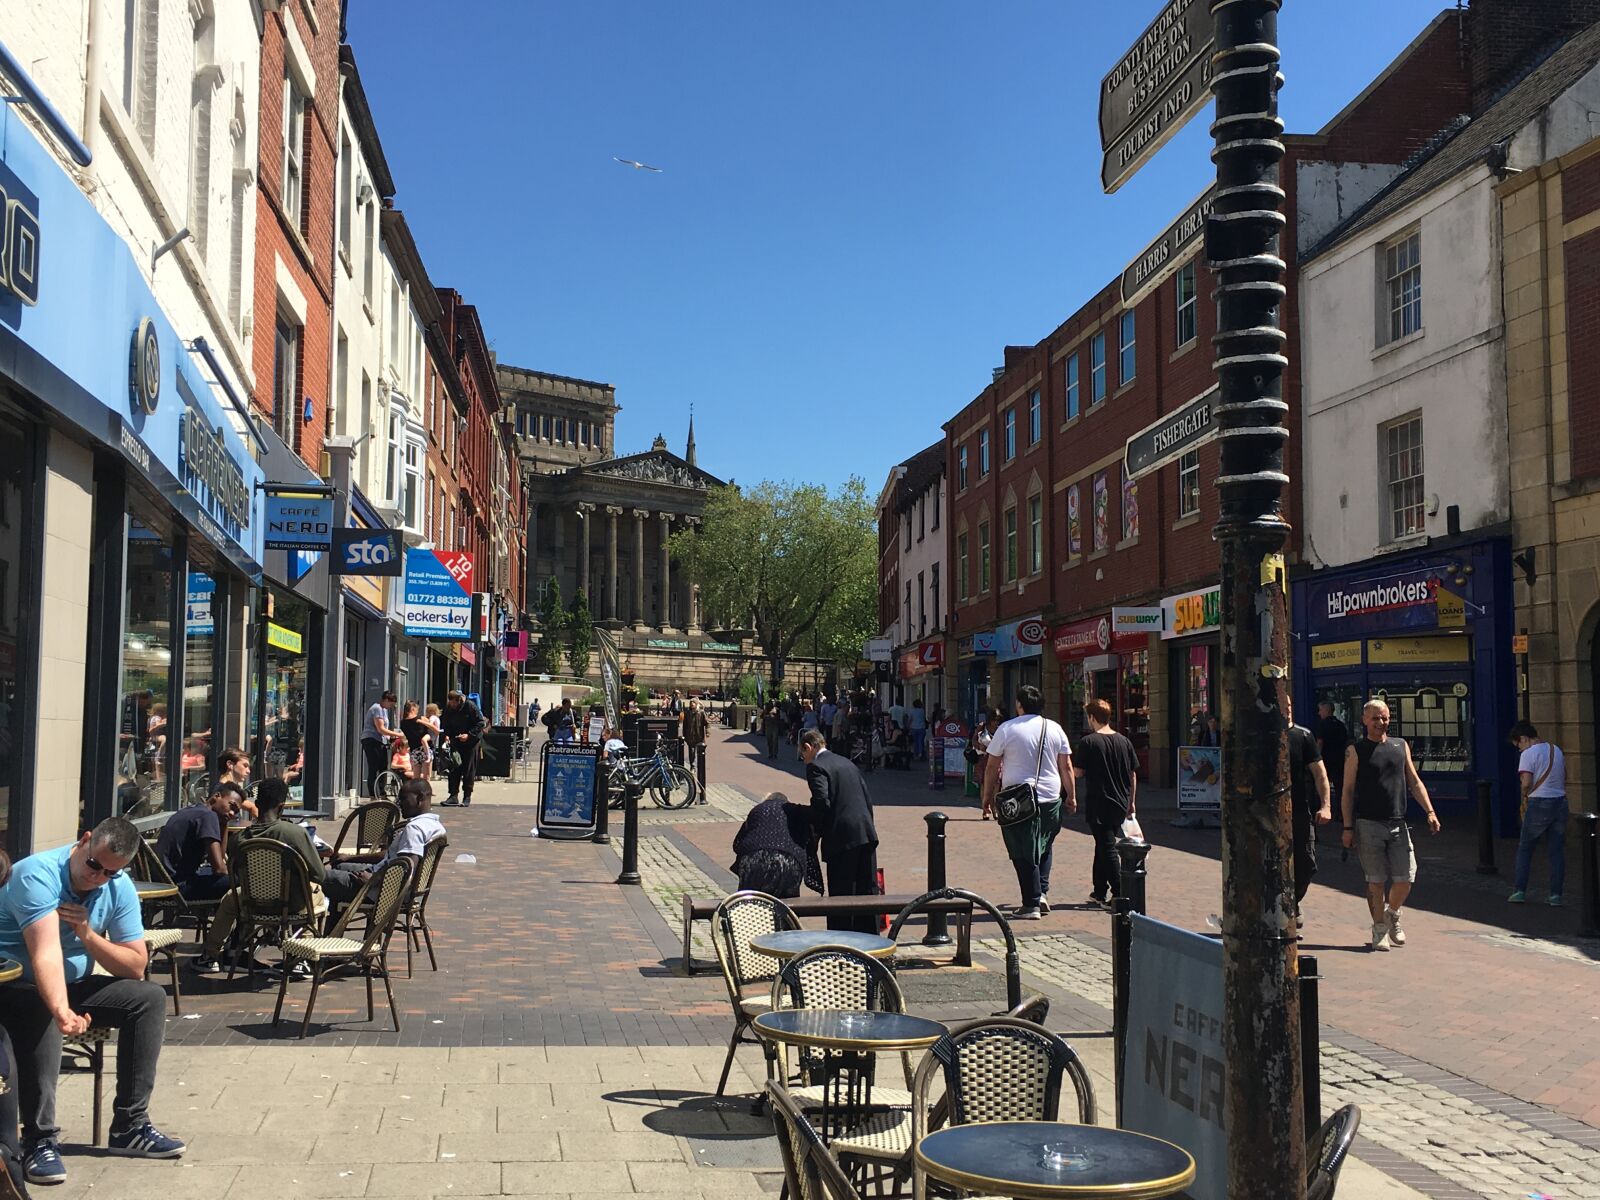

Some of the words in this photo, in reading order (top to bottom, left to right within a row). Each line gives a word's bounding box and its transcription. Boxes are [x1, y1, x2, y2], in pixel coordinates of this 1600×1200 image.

[1107, 43, 1142, 93] COUNTY
[1143, 0, 1193, 53] INFORMA
[1131, 36, 1168, 88] CENTRE
[1170, 17, 1187, 46] ON
[1127, 84, 1148, 116] BUS
[1148, 35, 1191, 93] STATION
[1118, 110, 1160, 167] TOURIST
[1164, 80, 1191, 122] INFO
[1135, 240, 1168, 285] HARRIS
[1153, 404, 1209, 454] FISHERGATE
[269, 522, 328, 534] NERO
[345, 540, 389, 564] sta
[456, 554, 472, 572] TO
[425, 572, 451, 580] Premises
[445, 559, 467, 582] LET
[407, 593, 436, 604] 01772
[436, 596, 470, 606] 883388
[1342, 580, 1428, 613] pawnbrokers
[407, 608, 469, 628] eckersley
[1117, 615, 1160, 624] SUBWAY
[1439, 607, 1464, 616] LOANS
[406, 628, 468, 636] eckersleyproperty.co.uk
[1320, 650, 1336, 660] LOANS
[548, 746, 597, 755] statravel.com
[1174, 1003, 1225, 1048] CAFF
[1144, 1025, 1226, 1132] NER
